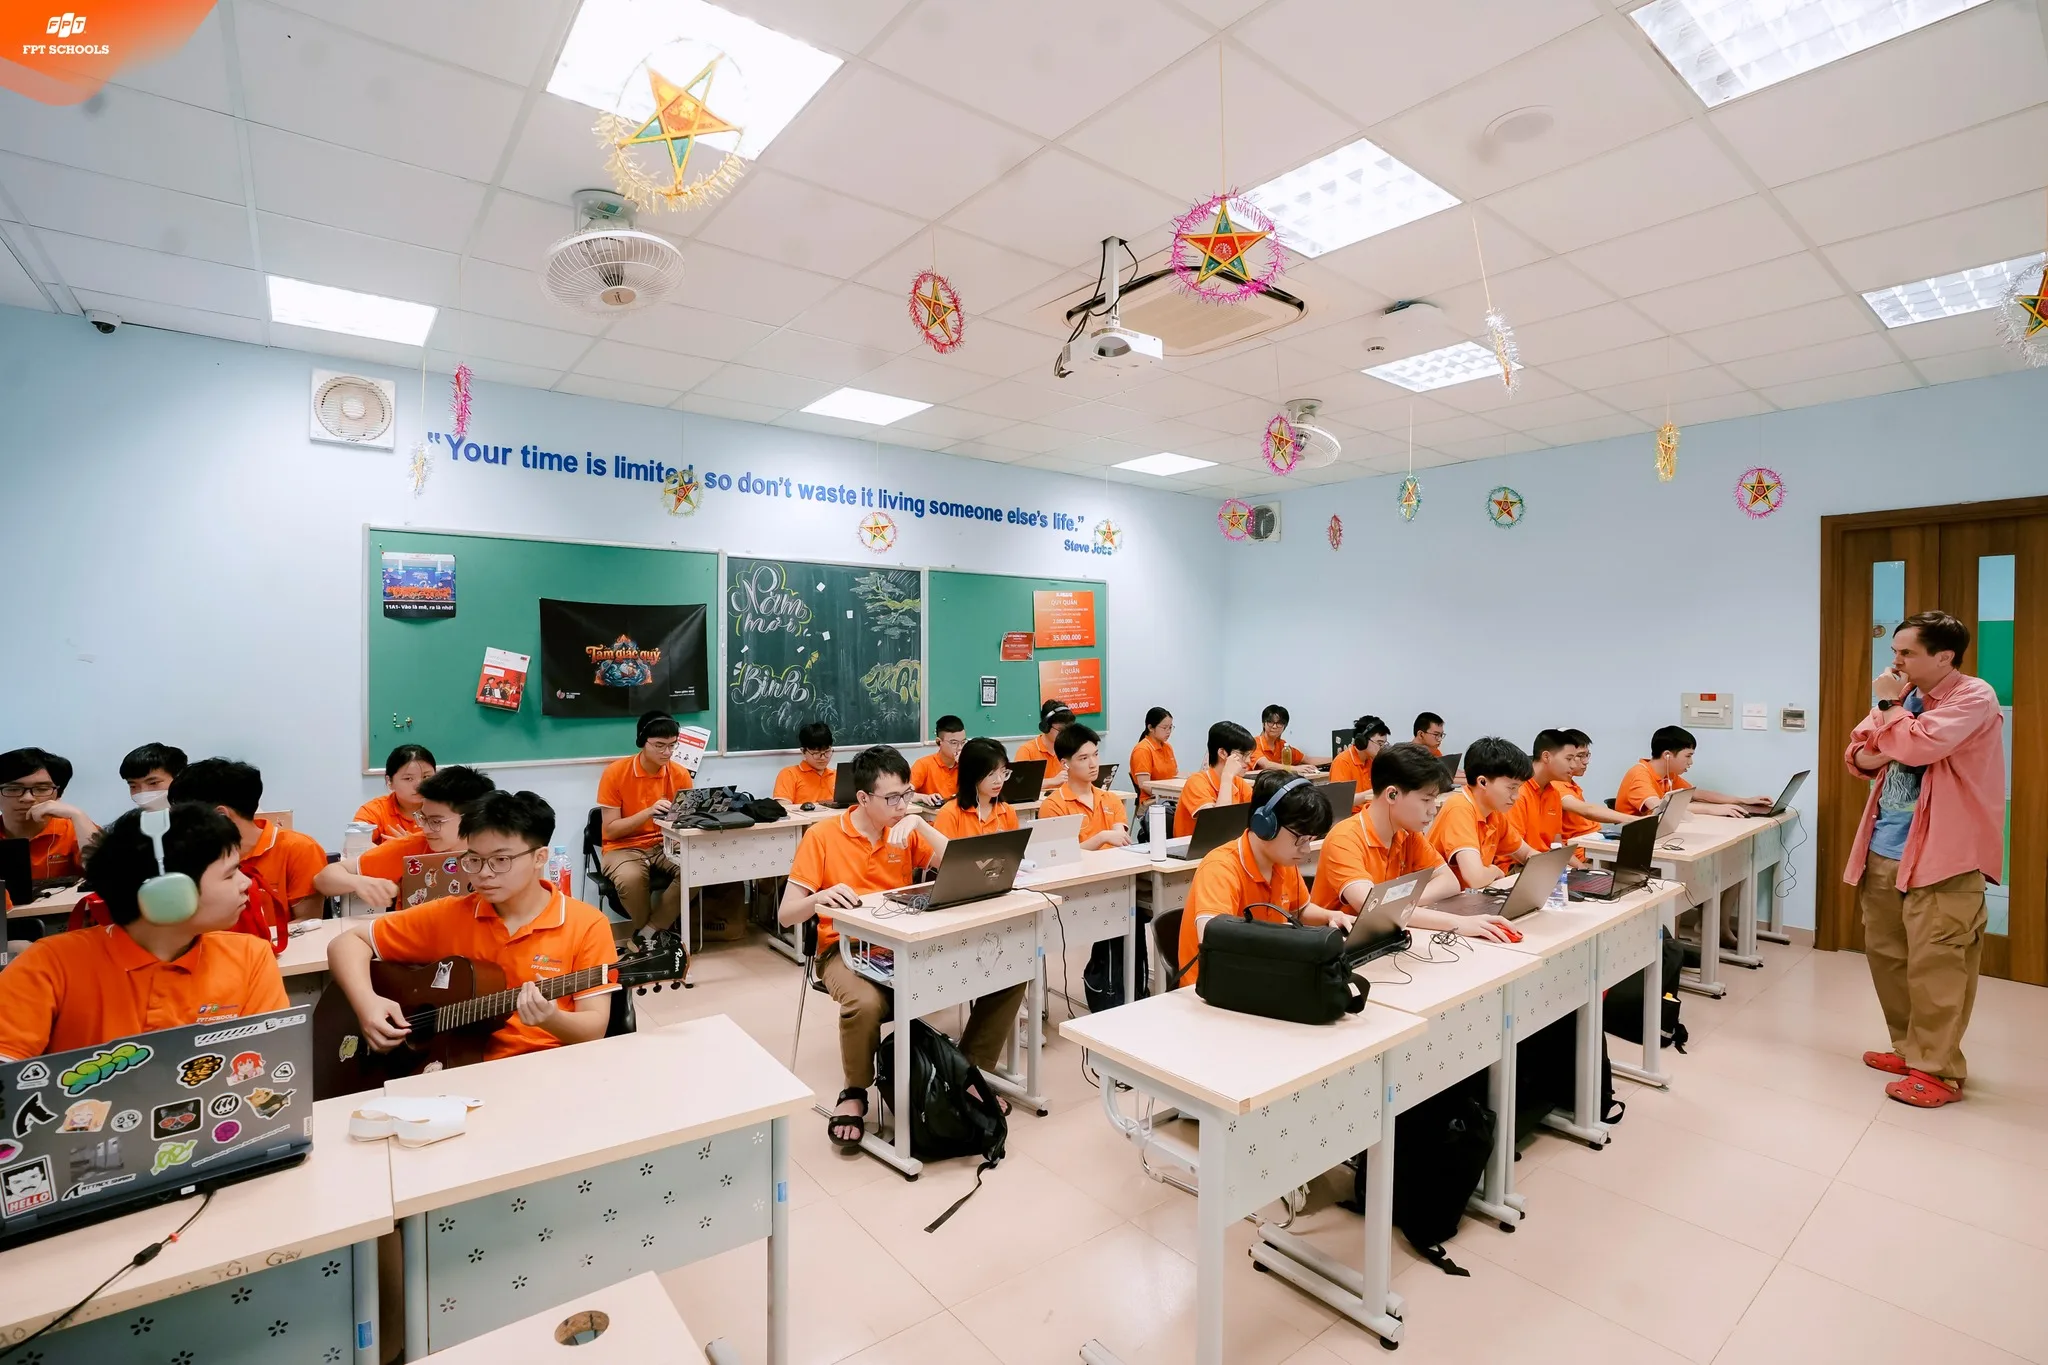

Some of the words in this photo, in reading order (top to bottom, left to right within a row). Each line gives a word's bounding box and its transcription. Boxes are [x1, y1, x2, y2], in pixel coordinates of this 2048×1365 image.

[521, 445, 578, 473] time
[586, 452, 606, 476] is
[704, 471, 732, 491] so
[738, 472, 792, 499] don’t
[798, 482, 857, 505] waste
[861, 487, 874, 507] it
[878, 489, 925, 517] living
[929, 500, 1003, 522] someone
[1007, 509, 1048, 528] else’s
[1064, 539, 1090, 553] Steve
[586, 644, 615, 664] Tam
[615, 647, 638, 663] giác
[9, 1192, 50, 1211] HELLO
